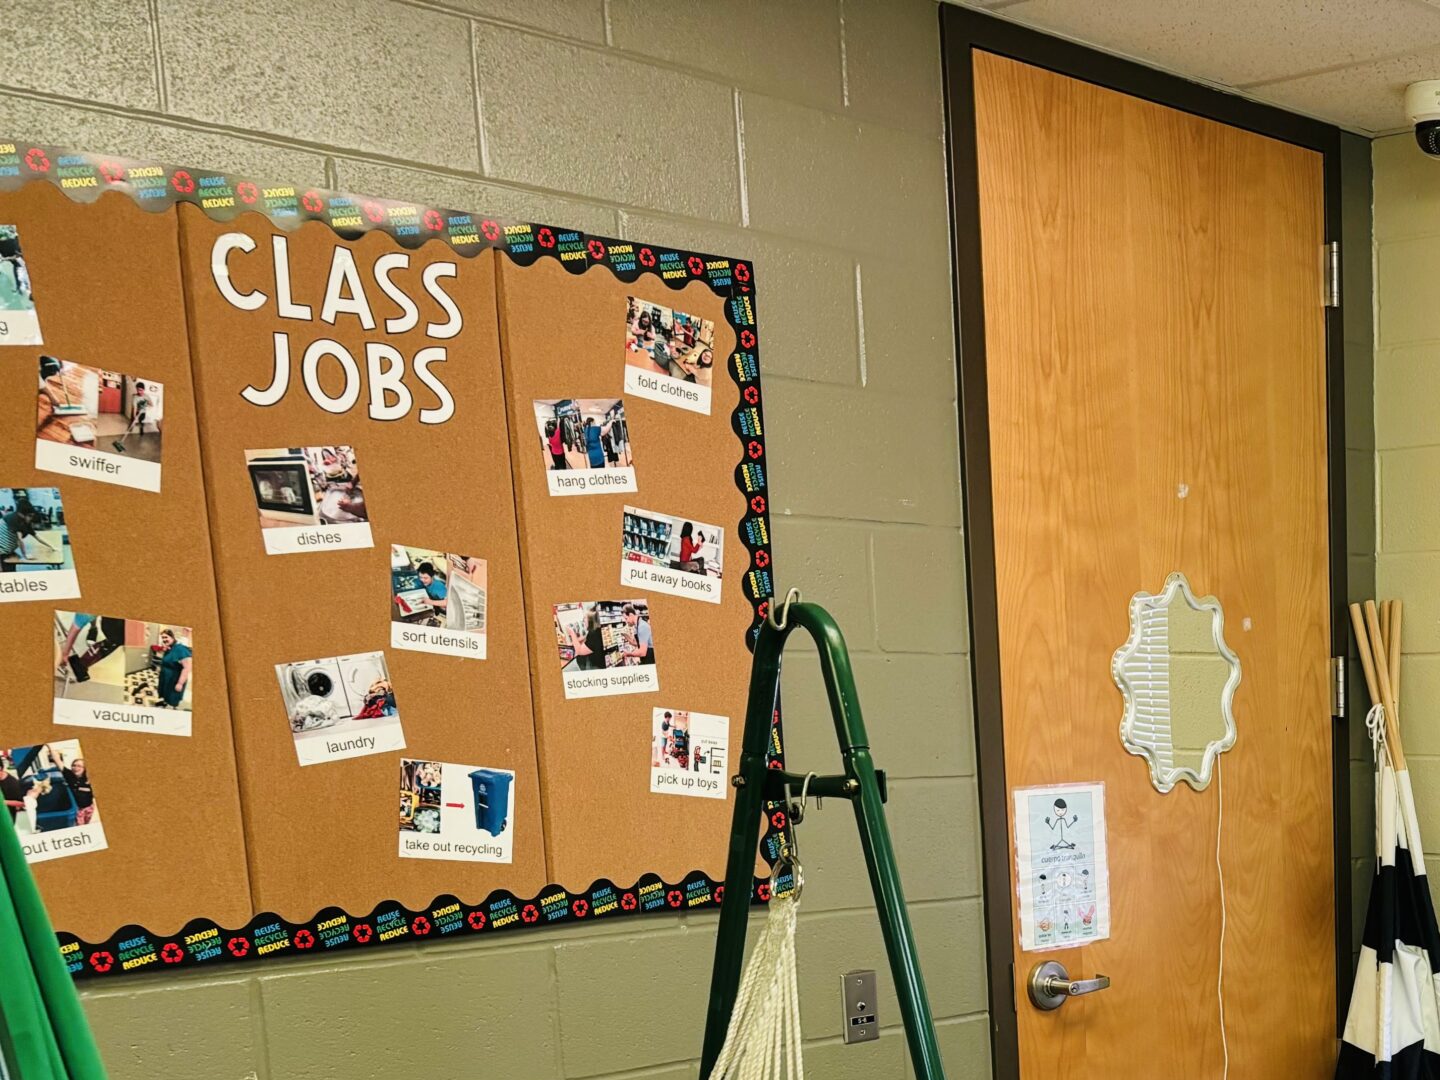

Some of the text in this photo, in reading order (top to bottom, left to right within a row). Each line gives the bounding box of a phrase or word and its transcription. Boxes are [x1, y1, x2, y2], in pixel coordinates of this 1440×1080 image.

[61, 177, 98, 189] REDUCE
[198, 186, 234, 198] RECYCLE
[262, 187, 295, 198] REDUCE
[202, 197, 235, 209] REDUCE
[331, 216, 363, 227] REDUCE
[448, 215, 472, 225] REUSE
[448, 225, 478, 236] RECYCLE
[504, 225, 532, 235] REDUCE
[558, 232, 580, 242] REUSE
[451, 234, 480, 245] REDUCE
[506, 234, 534, 244] RECYCLE
[557, 241, 585, 252] RECYCLE
[511, 243, 533, 253] REUSE
[607, 245, 633, 255] REDUCE
[560, 250, 587, 262] REDUCE
[609, 253, 636, 263] RECYCLE
[660, 253, 680, 261] REUSE
[616, 262, 636, 271] REUSE
[660, 261, 686, 271] RECYCLE
[706, 261, 729, 270] REDUCE
[662, 269, 687, 280] REDUCE
[708, 269, 732, 278] RECYCLE
[211, 232, 463, 340] CLASS
[713, 278, 731, 287] REUSE
[731, 300, 741, 324] REUSE
[743, 295, 754, 325] REDUCE
[734, 353, 746, 382] REDUCE
[748, 354, 757, 377] REUSE
[240, 332, 456, 425] JOBS
[637, 374, 699, 402] fold clothes
[738, 412, 749, 435] REUSE
[751, 407, 762, 435] REDUCE
[69, 453, 122, 475] swiffer
[557, 473, 628, 491] hang clothes
[741, 464, 753, 492] REDUCE
[755, 464, 765, 487] REUSE
[297, 531, 342, 545] dishes
[746, 521, 755, 544] REUSE
[758, 517, 768, 544] REDUCE
[630, 568, 712, 593] put away books
[749, 571, 760, 598] REDUCE
[762, 571, 772, 593] REUSE
[402, 630, 479, 650] sort utensils
[567, 672, 650, 689] stocking supplies
[93, 709, 155, 726] vacuum
[326, 734, 375, 753] laundry
[657, 773, 718, 790] pick up toys
[22, 831, 92, 855] out trash
[405, 838, 502, 857] take out recycling
[592, 887, 612, 899] REUSE
[639, 881, 663, 895] REDUCE
[686, 887, 710, 899] RECYCLE
[687, 880, 706, 891] REUSE
[490, 898, 512, 911] REUSE
[540, 891, 566, 906] REDUCE
[592, 893, 617, 908] RECYCLE
[645, 899, 664, 910] REUSE
[688, 894, 711, 907] REDUCE
[432, 903, 460, 919] REDUCE
[490, 905, 518, 920] RECYCLE
[542, 900, 568, 914] RECYCLE
[547, 908, 568, 921] REUSE
[594, 901, 619, 915] REDUCE
[317, 915, 347, 931] REDUCE
[377, 909, 400, 923] REUSE
[434, 911, 464, 927] RECYCLE
[492, 913, 519, 928] REDUCE
[254, 922, 280, 937] REUSE
[319, 924, 350, 940] RECYCLE
[376, 917, 407, 933] RECYCLE
[441, 920, 463, 934] REUSE
[184, 927, 219, 945] REDUCE
[254, 930, 288, 947] RECYCLE
[325, 933, 349, 947] REUSE
[379, 925, 409, 941] REDUCE
[59, 941, 80, 954] RED
[118, 935, 147, 951] REUSE
[187, 936, 222, 954] RECYCLE
[257, 938, 290, 956] REDUCE
[118, 943, 155, 961] RECYCLE
[195, 946, 222, 961] REUSE
[122, 952, 158, 970] REDUCE
